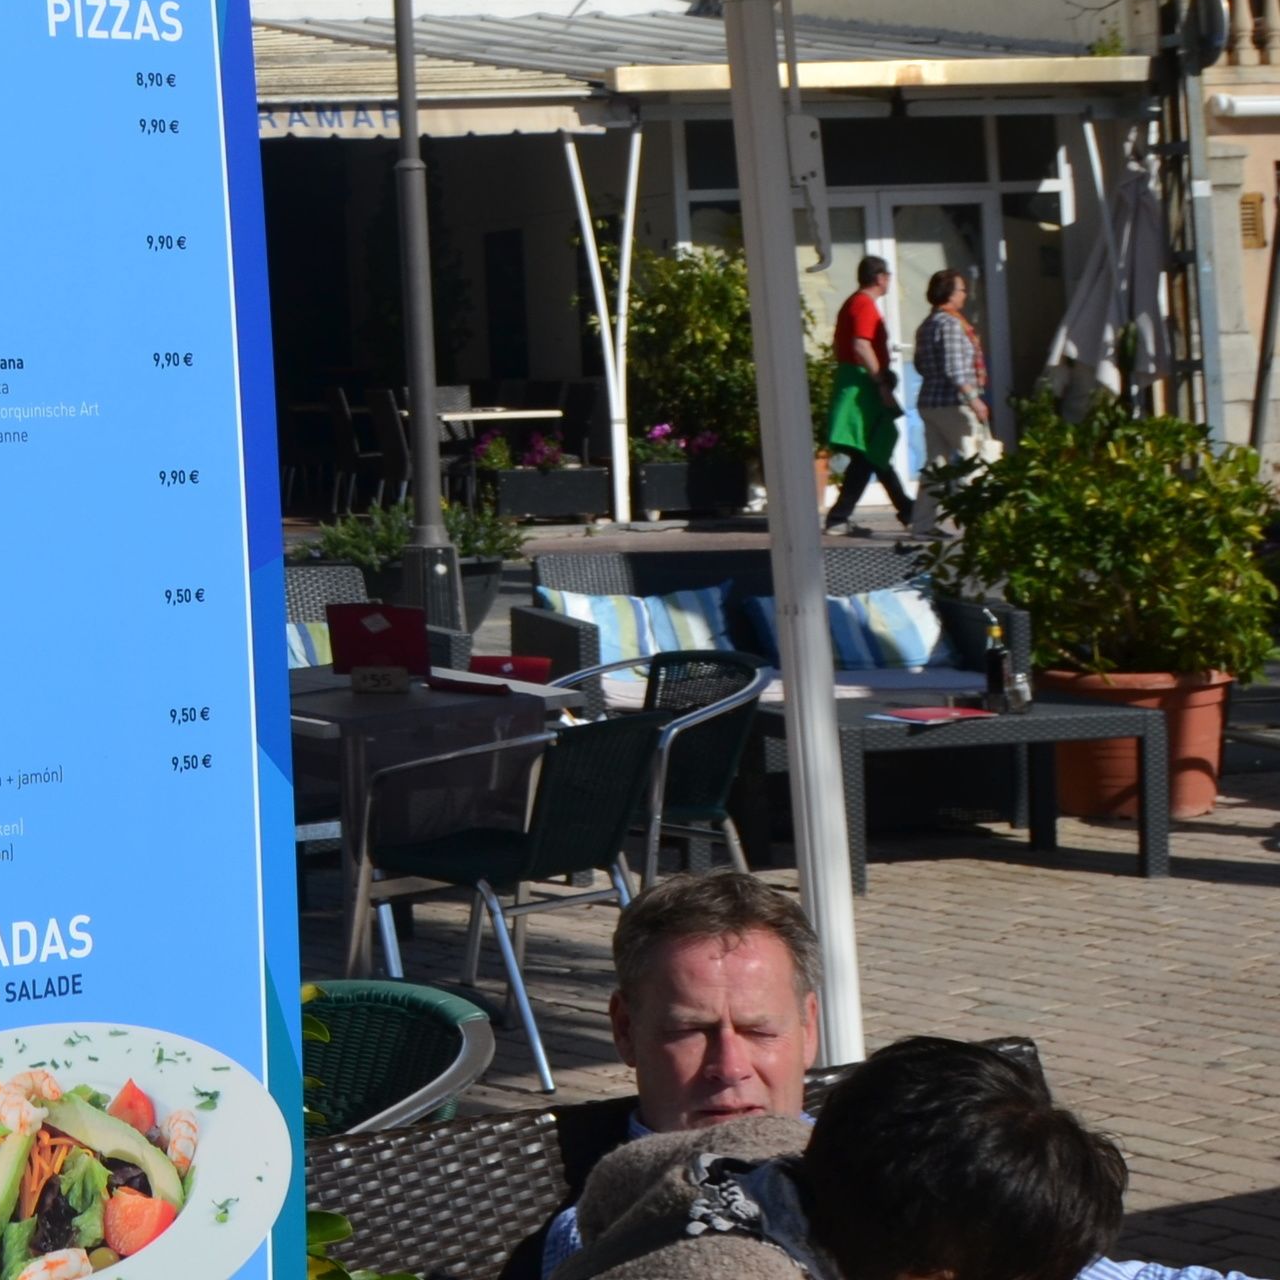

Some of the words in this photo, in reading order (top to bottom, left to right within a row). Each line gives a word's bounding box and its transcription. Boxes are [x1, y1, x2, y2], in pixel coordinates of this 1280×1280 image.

[137, 72, 162, 88] 8,90
[166, 74, 176, 87] €
[139, 119, 165, 135] 9,90
[169, 120, 179, 133] €
[147, 235, 173, 251] 9,90
[177, 236, 186, 249] €
[153, 352, 179, 369] 9,90
[183, 353, 192, 366] €
[80, 401, 99, 416] Art
[159, 470, 185, 487] 9,90
[189, 470, 199, 484] €
[165, 589, 191, 606] 9,50
[195, 588, 204, 602] €
[170, 707, 196, 725] 9,50
[200, 707, 209, 721] €
[172, 755, 198, 772] 9,50
[202, 754, 211, 768] €
[7, 776, 13, 784] +
[18, 765, 62, 789] jamón)
[5, 974, 82, 1002] SALADE
